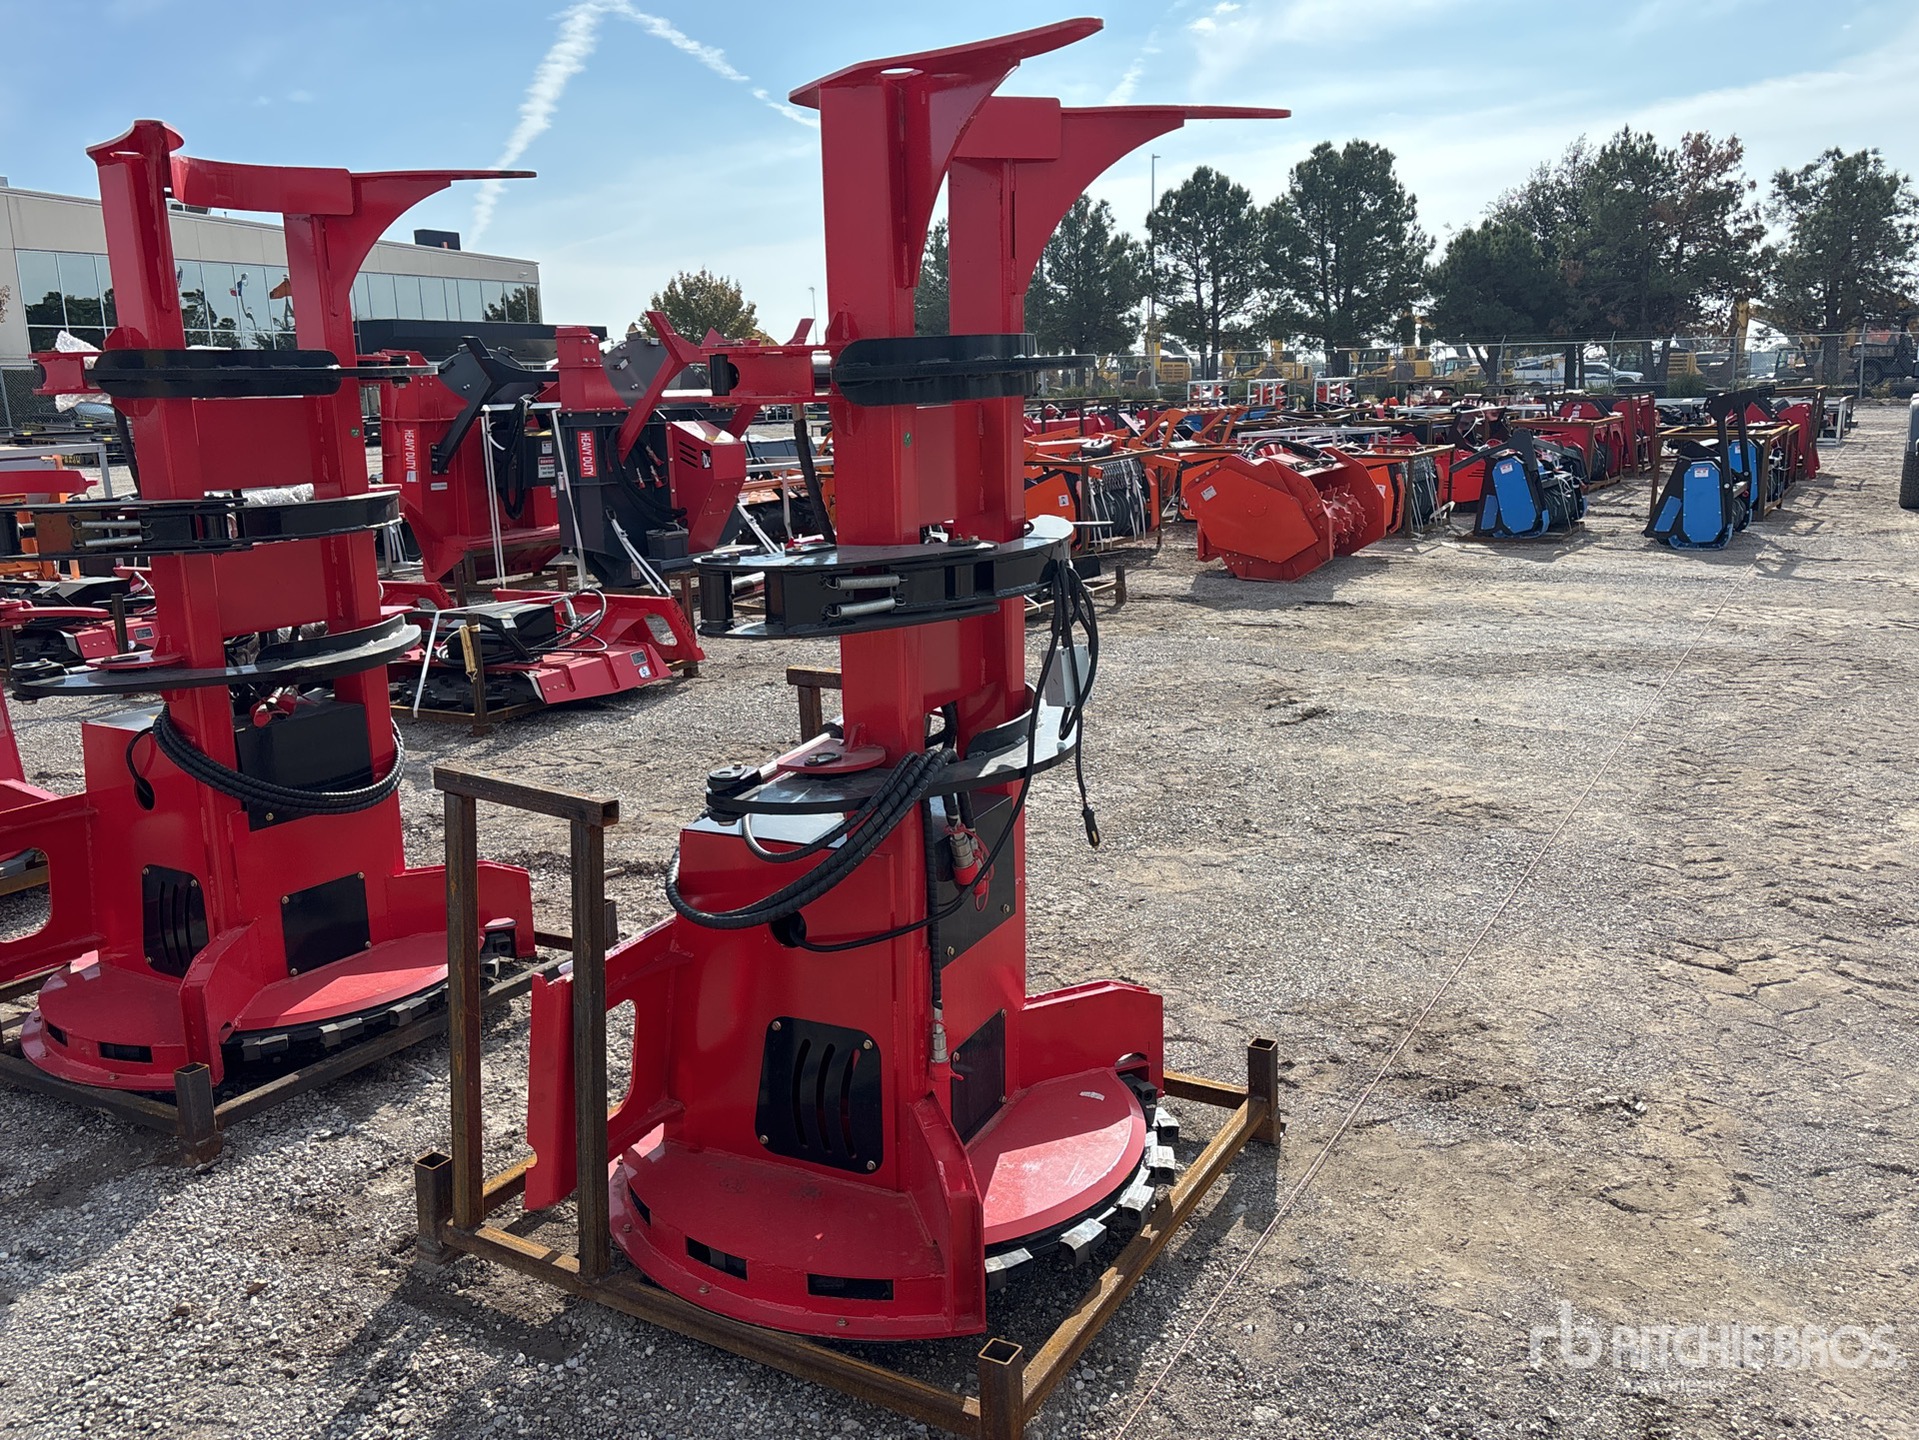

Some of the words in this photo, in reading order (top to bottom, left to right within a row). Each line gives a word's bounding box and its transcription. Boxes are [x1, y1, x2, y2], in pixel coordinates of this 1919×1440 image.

[404, 429, 415, 451] HEAVY
[580, 432, 592, 456] HEAVY
[405, 451, 416, 470] DUTY
[582, 456, 594, 476] DUTY
